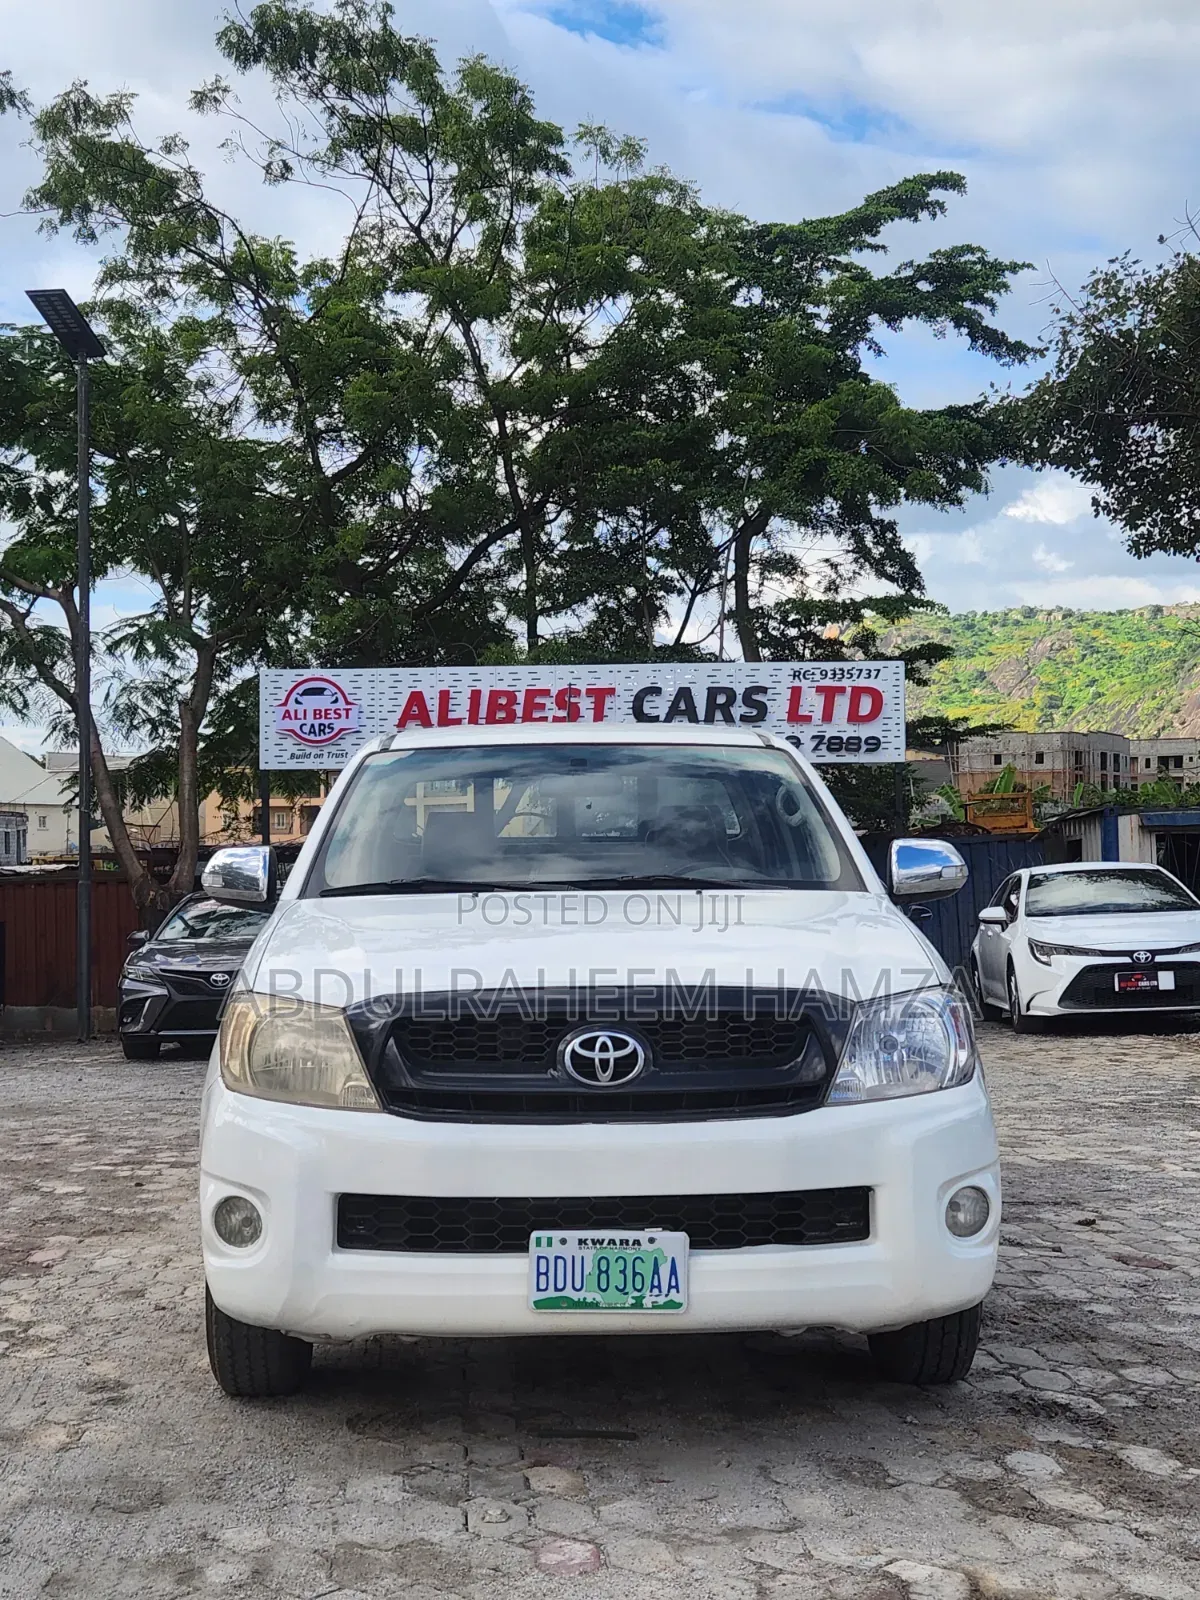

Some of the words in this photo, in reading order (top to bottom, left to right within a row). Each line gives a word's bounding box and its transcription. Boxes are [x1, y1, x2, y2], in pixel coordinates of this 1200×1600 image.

[281, 709, 307, 721] ALI
[313, 707, 352, 720] BEST
[397, 687, 616, 728] ALIBEST
[632, 686, 768, 723] CARS
[786, 685, 884, 723] LTD
[299, 722, 334, 737] CARS
[810, 734, 881, 753] 7889
[289, 752, 312, 760] Build
[327, 751, 349, 759] Trust
[577, 1238, 642, 1246] KWARA
[536, 1255, 585, 1292] BDU
[597, 1255, 680, 1294] 836AA
